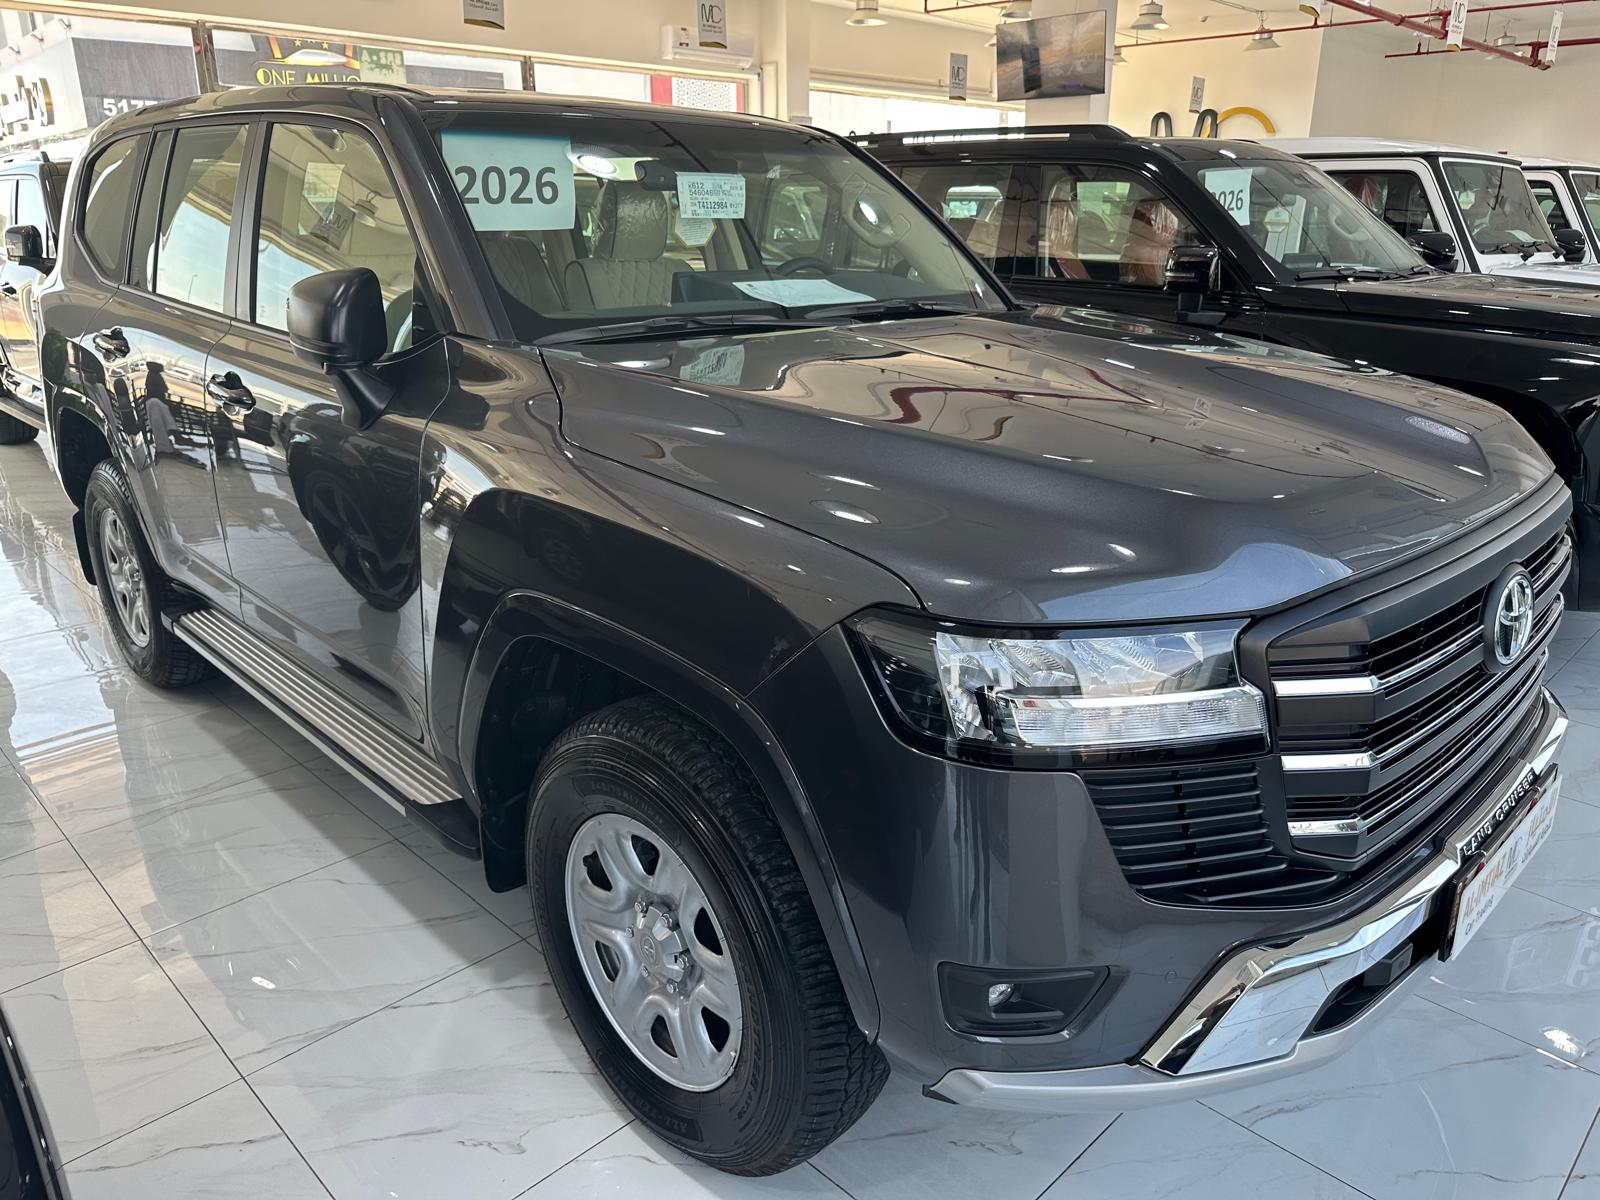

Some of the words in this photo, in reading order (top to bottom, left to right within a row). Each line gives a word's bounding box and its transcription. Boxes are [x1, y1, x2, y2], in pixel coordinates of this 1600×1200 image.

[701, 3, 722, 24] MC
[951, 65, 965, 82] MC
[454, 165, 559, 205] 2026
[1211, 189, 1244, 211] 026
[1463, 821, 1493, 856] LAND
[1495, 771, 1534, 821] CRUISER
